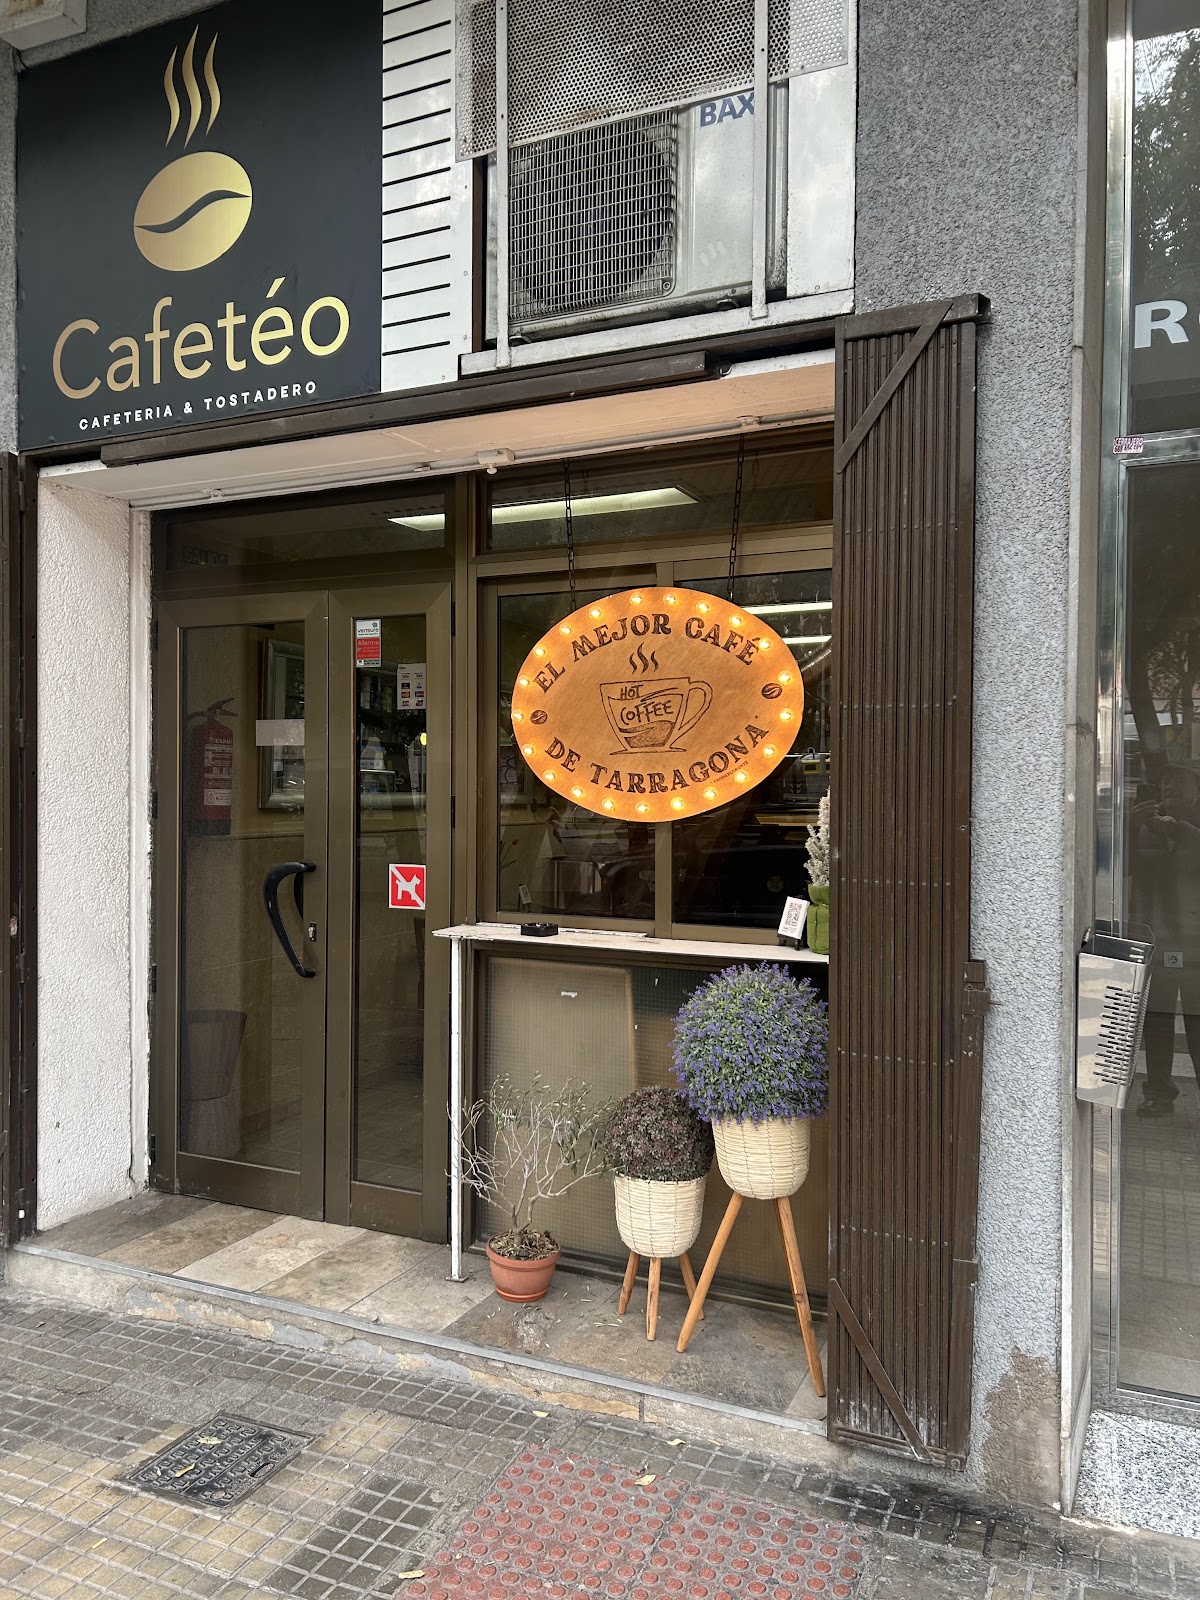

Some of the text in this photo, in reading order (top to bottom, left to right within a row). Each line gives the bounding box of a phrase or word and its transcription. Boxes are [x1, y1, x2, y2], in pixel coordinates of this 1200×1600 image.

[52, 277, 350, 400] Cafetéo
[1133, 300, 1200, 348] R
[78, 381, 317, 431] CAFETERIA & TOSTADERO
[533, 613, 760, 694] EL MEJOR CAFÉ
[620, 684, 643, 701] HOT
[544, 720, 769, 794] DE TARRAGONA
